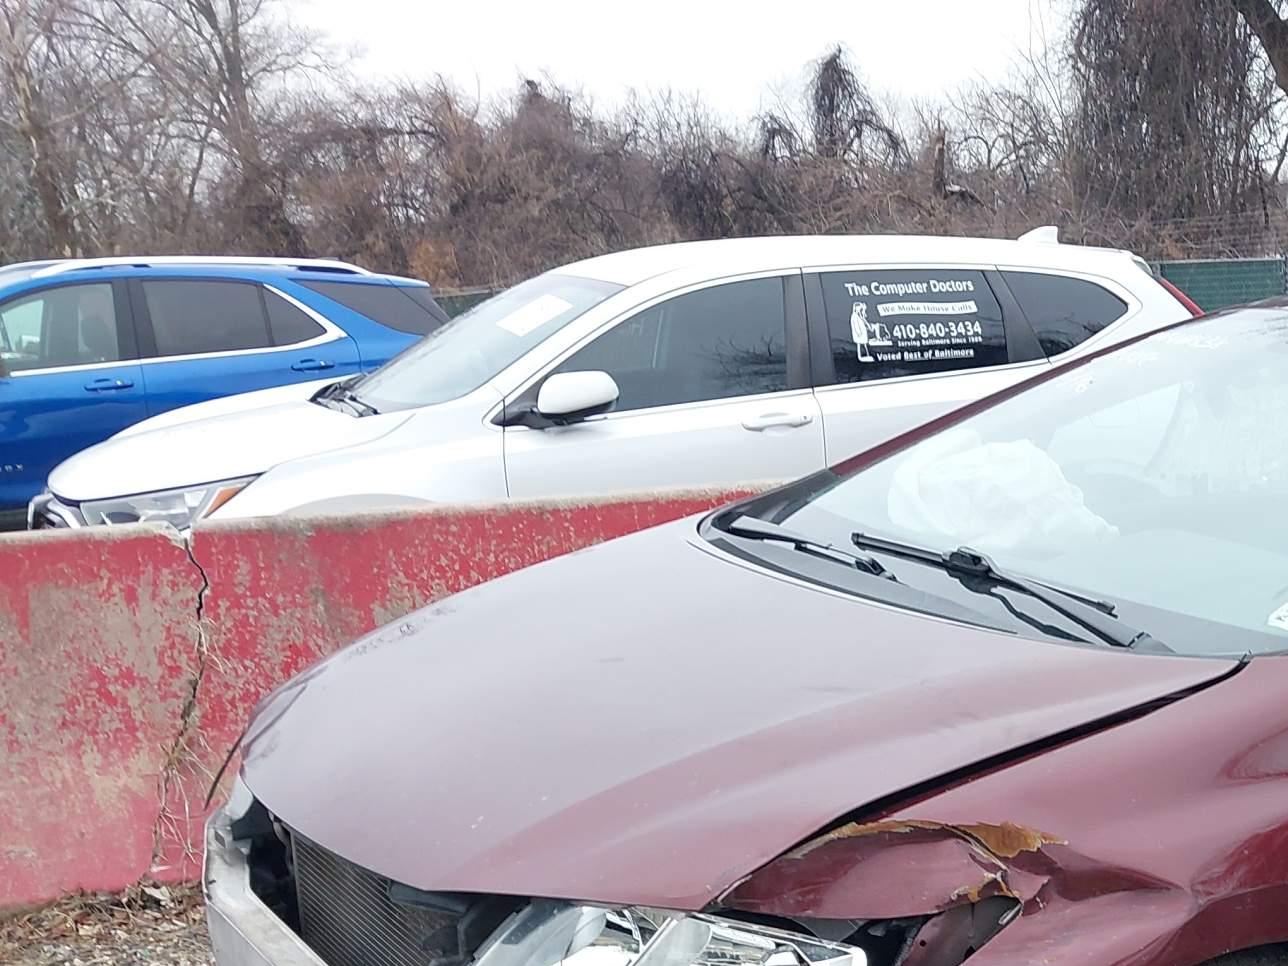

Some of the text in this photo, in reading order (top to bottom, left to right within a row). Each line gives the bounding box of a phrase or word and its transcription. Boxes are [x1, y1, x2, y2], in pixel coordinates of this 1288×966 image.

[845, 280, 974, 296] The Computer Doctors
[881, 303, 973, 313] We Make House Calls
[877, 348, 975, 361] Voted Best of Baltimore
